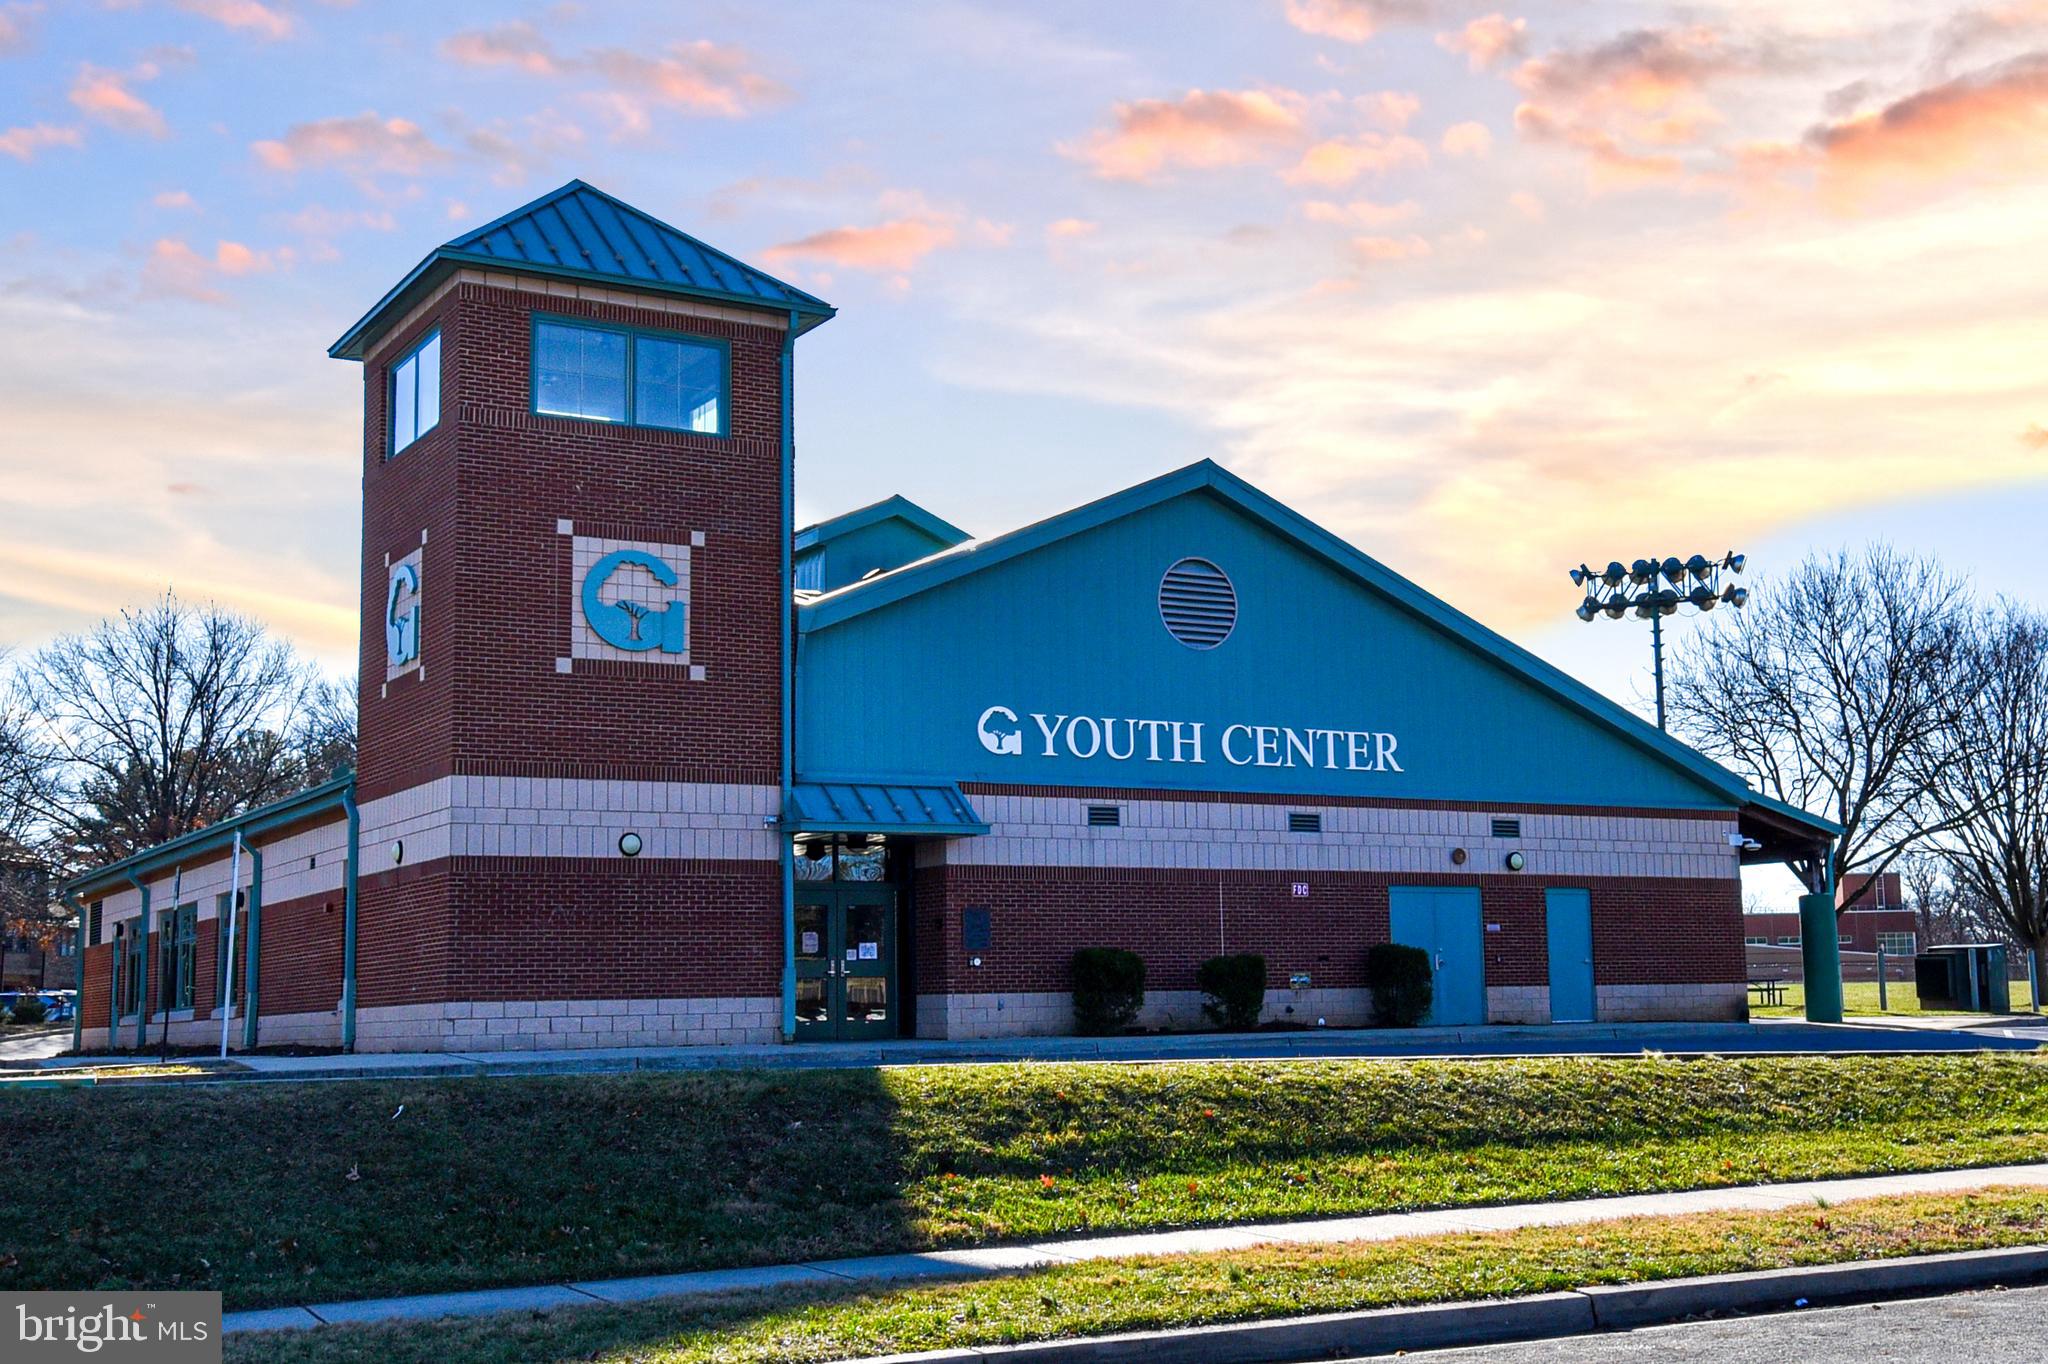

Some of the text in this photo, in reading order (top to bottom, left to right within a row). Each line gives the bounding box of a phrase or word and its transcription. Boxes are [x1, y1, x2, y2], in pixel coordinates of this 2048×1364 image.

[580, 550, 685, 655] G
[1029, 713, 1206, 764] YOUTH
[1221, 724, 1405, 773] CENTER
